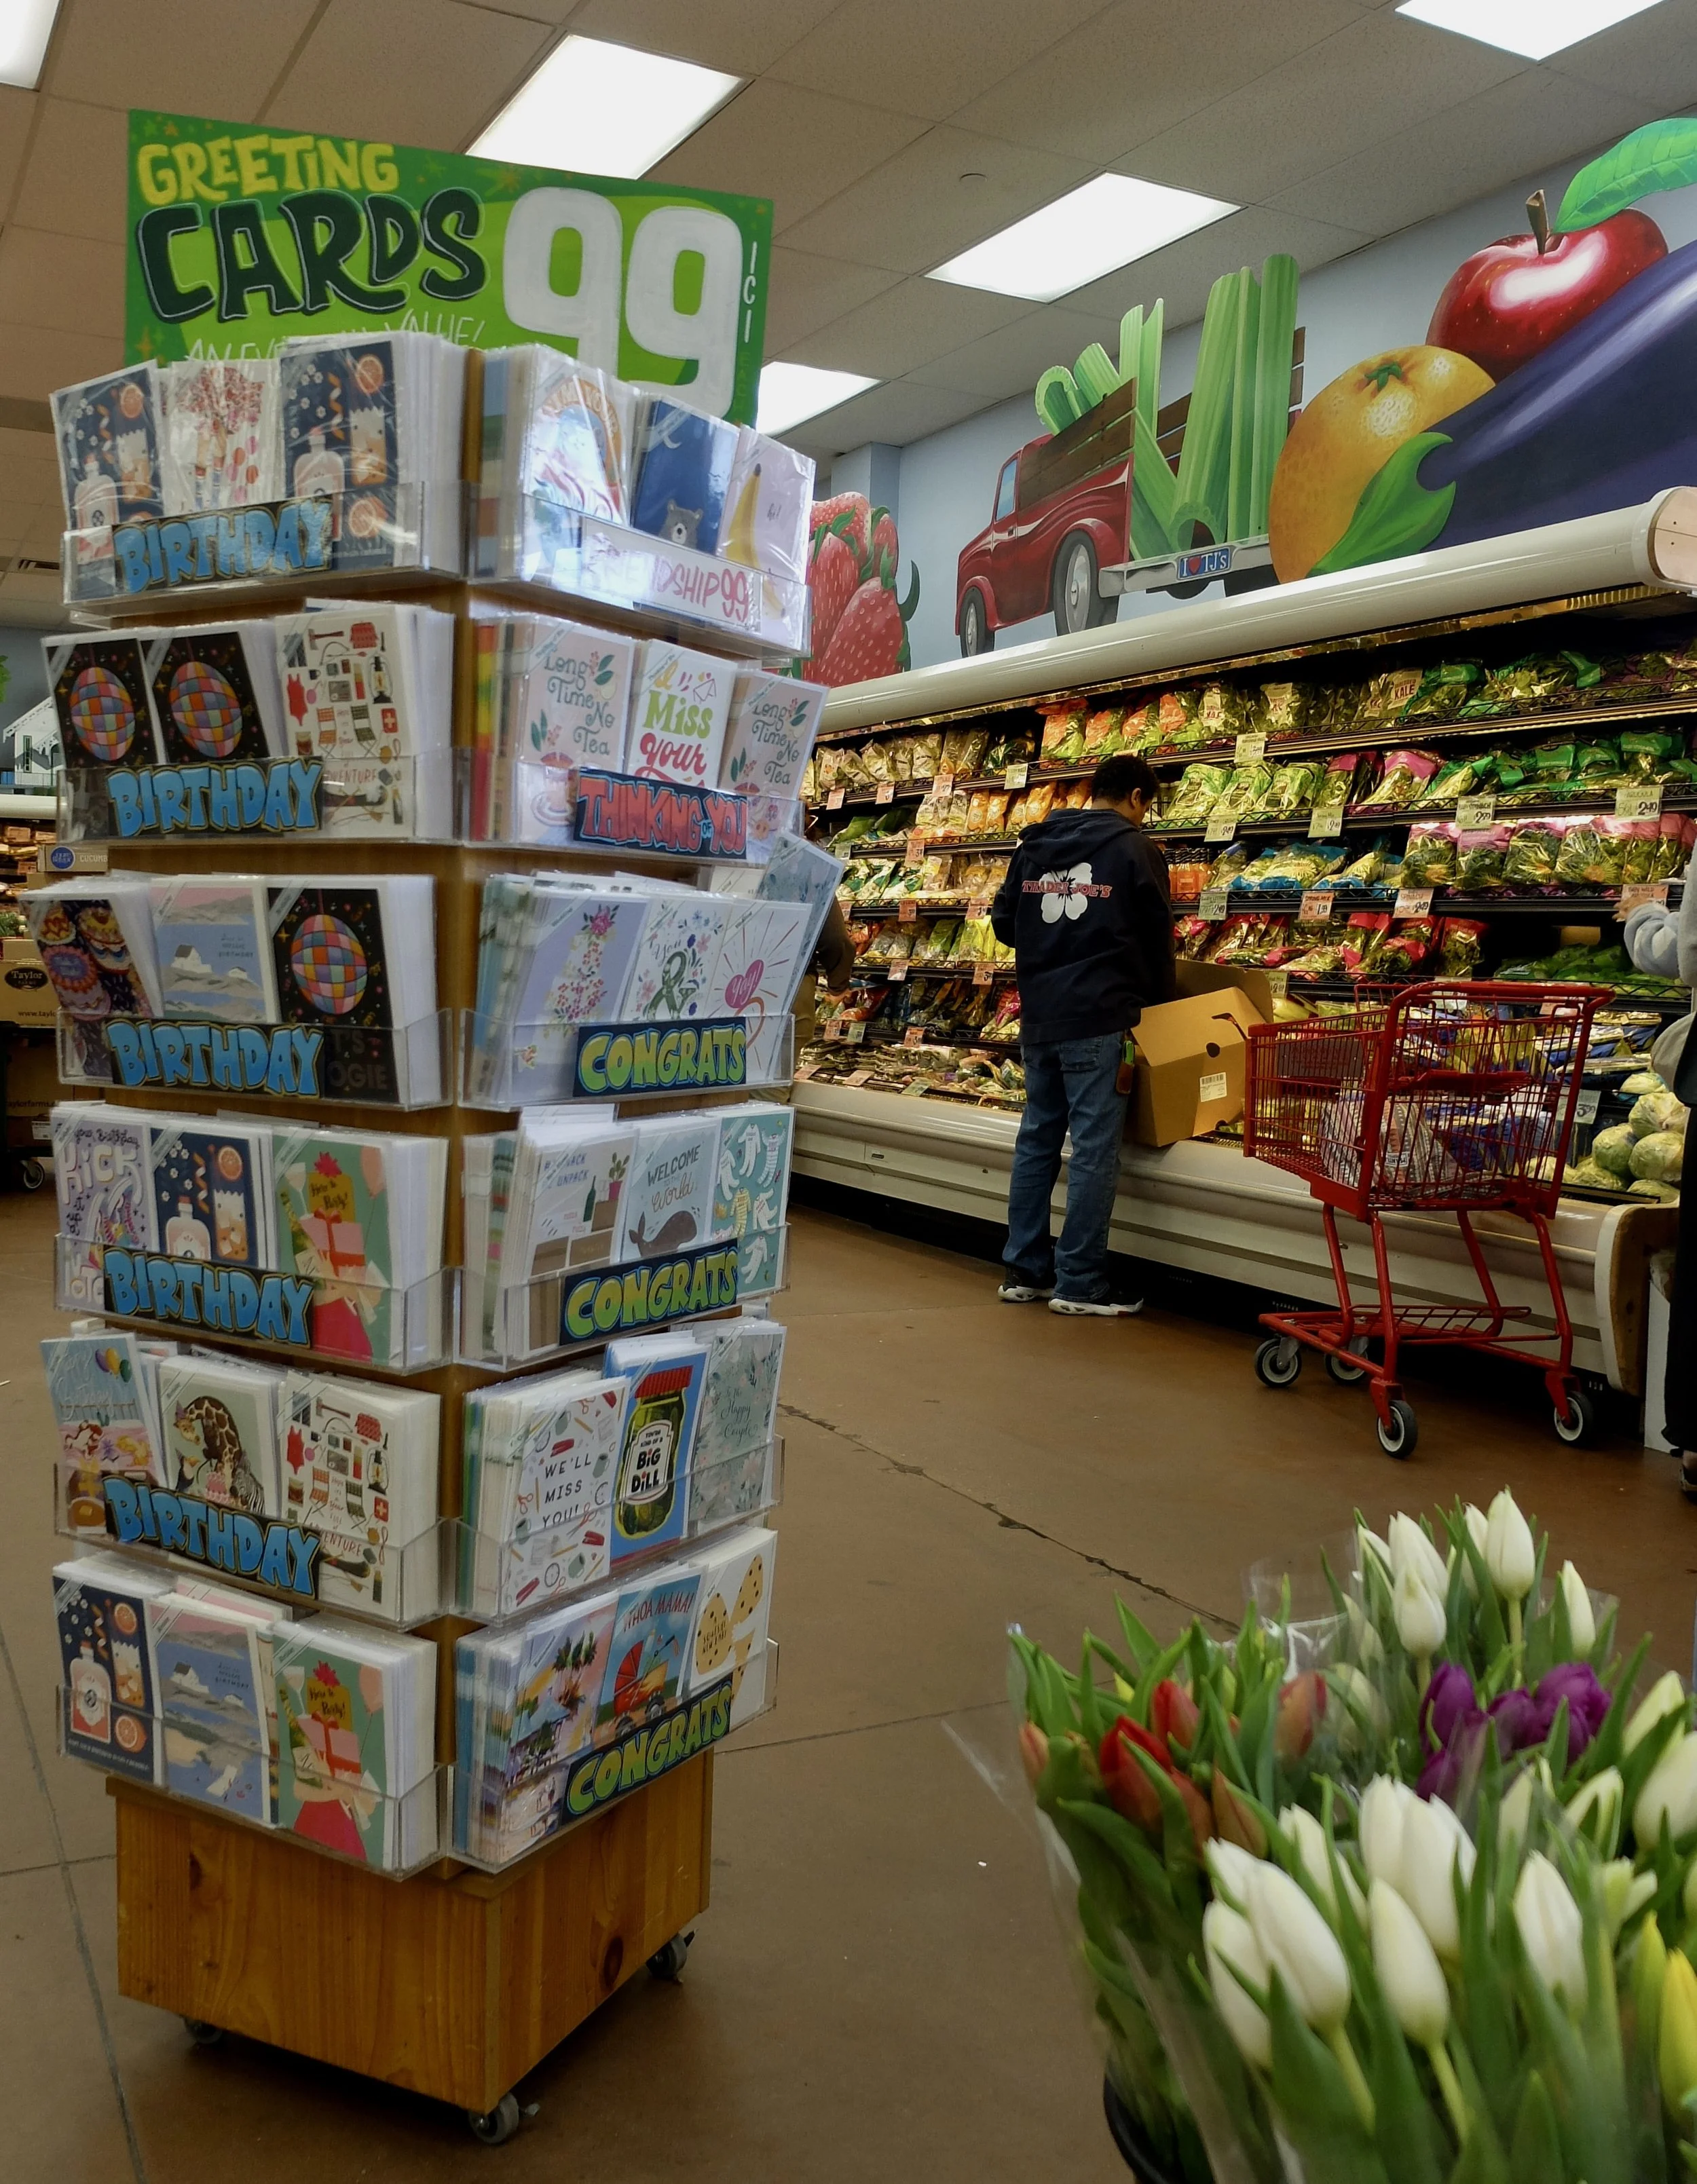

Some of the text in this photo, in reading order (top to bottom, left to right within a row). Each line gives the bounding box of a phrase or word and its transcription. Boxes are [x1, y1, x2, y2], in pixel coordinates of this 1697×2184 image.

[138, 134, 399, 205] GREETING
[136, 186, 489, 322] CARDS
[113, 498, 333, 592] BIRTHDAY
[1201, 551, 1227, 573] TJ's
[544, 653, 589, 691] Long
[547, 675, 594, 709] Time
[1394, 684, 1415, 700] KALE
[642, 689, 713, 739] Miss
[751, 719, 787, 747] Time
[753, 702, 787, 732] Long
[573, 726, 610, 756] Tea
[764, 760, 791, 785] Tea
[107, 759, 322, 837] BIRTHDAY
[578, 776, 703, 851] THINKING
[704, 793, 747, 853] YOU
[11, 971, 43, 980] Taylor
[106, 1019, 324, 1098] BIRTHDAY
[327, 1060, 388, 1090] OGIE
[579, 1024, 746, 1093] CONGRATS
[648, 1144, 701, 1186] WELCOME
[103, 1249, 316, 1347] BIRTHDAY
[563, 1246, 738, 1340] CONGRATS
[545, 1453, 591, 1479] WE'LL
[545, 1480, 582, 1504] MISS
[102, 1476, 322, 1600] BIRTHDAY
[654, 1591, 695, 1615] MAMA!
[567, 1680, 732, 1815] CONGRATS
